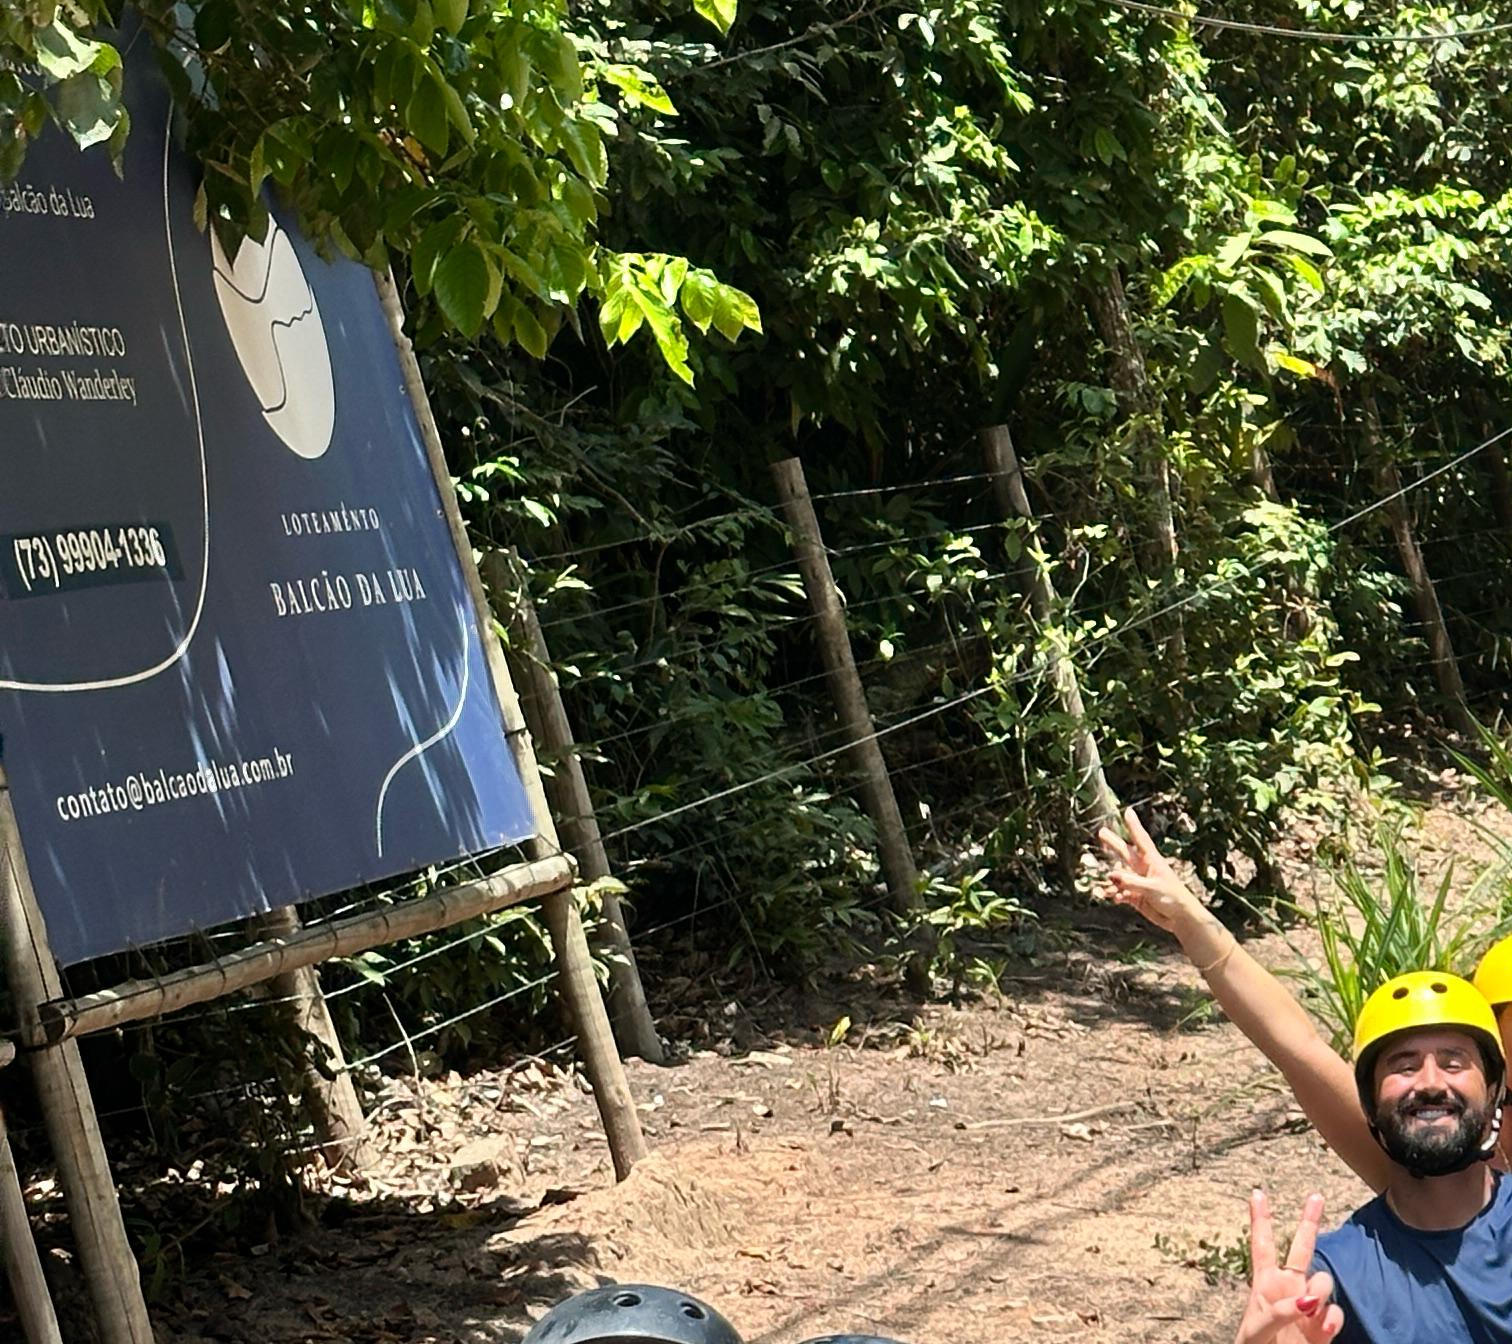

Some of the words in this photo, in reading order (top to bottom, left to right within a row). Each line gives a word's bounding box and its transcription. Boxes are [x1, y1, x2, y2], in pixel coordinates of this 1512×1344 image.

[49, 184, 69, 216] da
[66, 187, 95, 219] Lua
[0, 322, 24, 355] TO
[24, 320, 126, 357] URBANÍSTICO
[60, 368, 137, 407] Wanderley
[13, 535, 61, 592] (73)
[55, 526, 166, 575] 99904-1336
[269, 569, 352, 617] BALCÃO
[354, 572, 387, 606] DA
[386, 567, 427, 603] LUA
[56, 746, 295, 822] contato@balcaodalua.com.br
